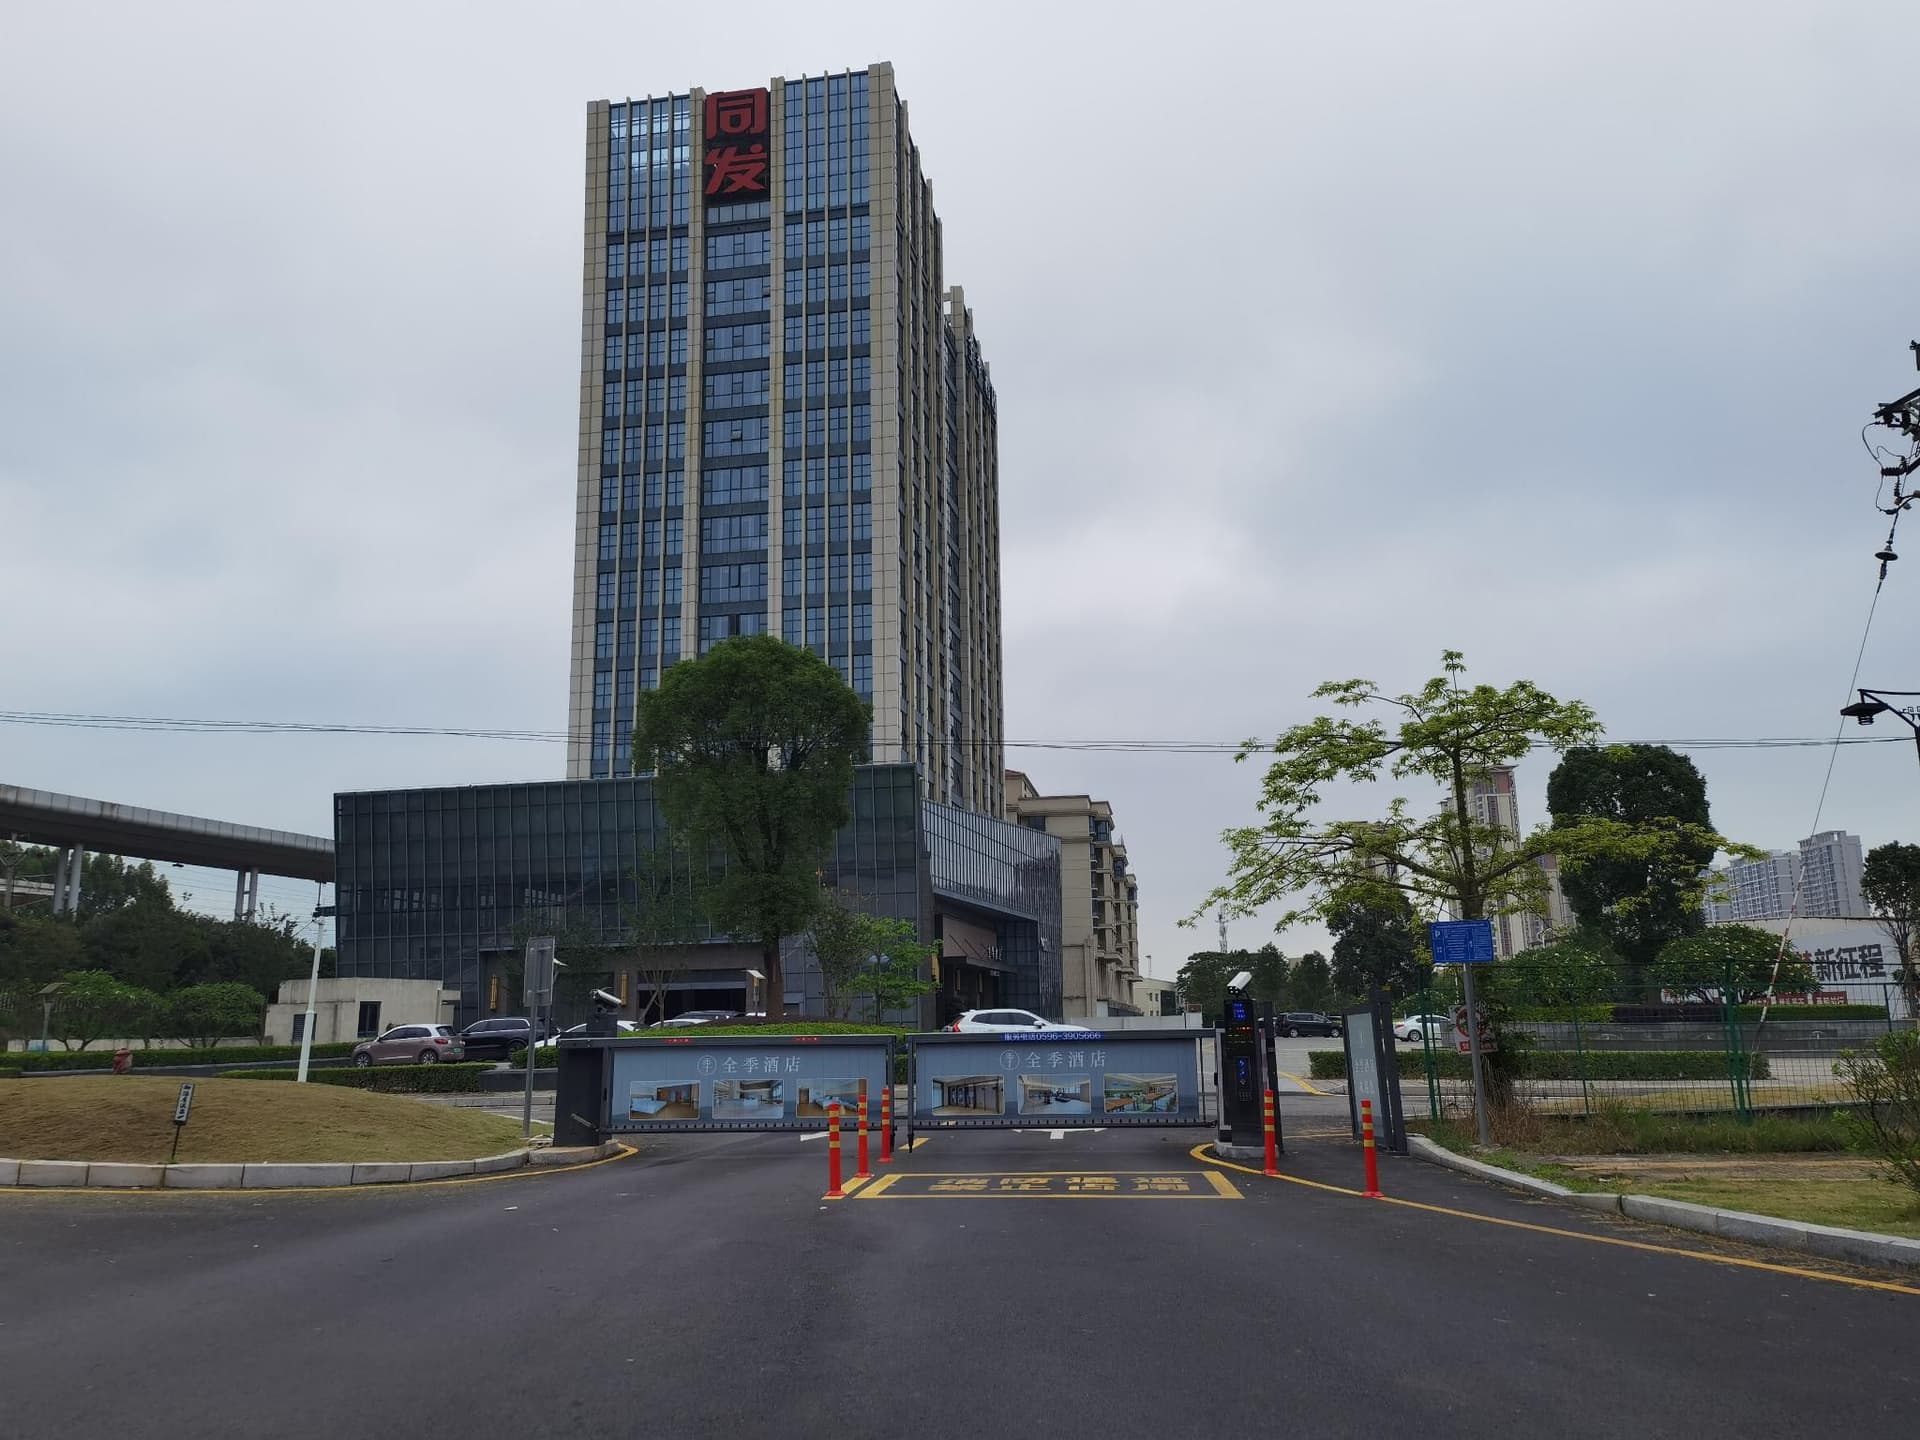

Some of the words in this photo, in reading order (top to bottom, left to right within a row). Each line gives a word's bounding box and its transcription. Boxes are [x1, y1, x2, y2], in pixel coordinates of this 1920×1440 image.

[704, 87, 768, 194] 同发
[1798, 944, 1886, 982] 新征程
[721, 1055, 801, 1073] 全季酒店
[1025, 1050, 1107, 1068] 全季酒店
